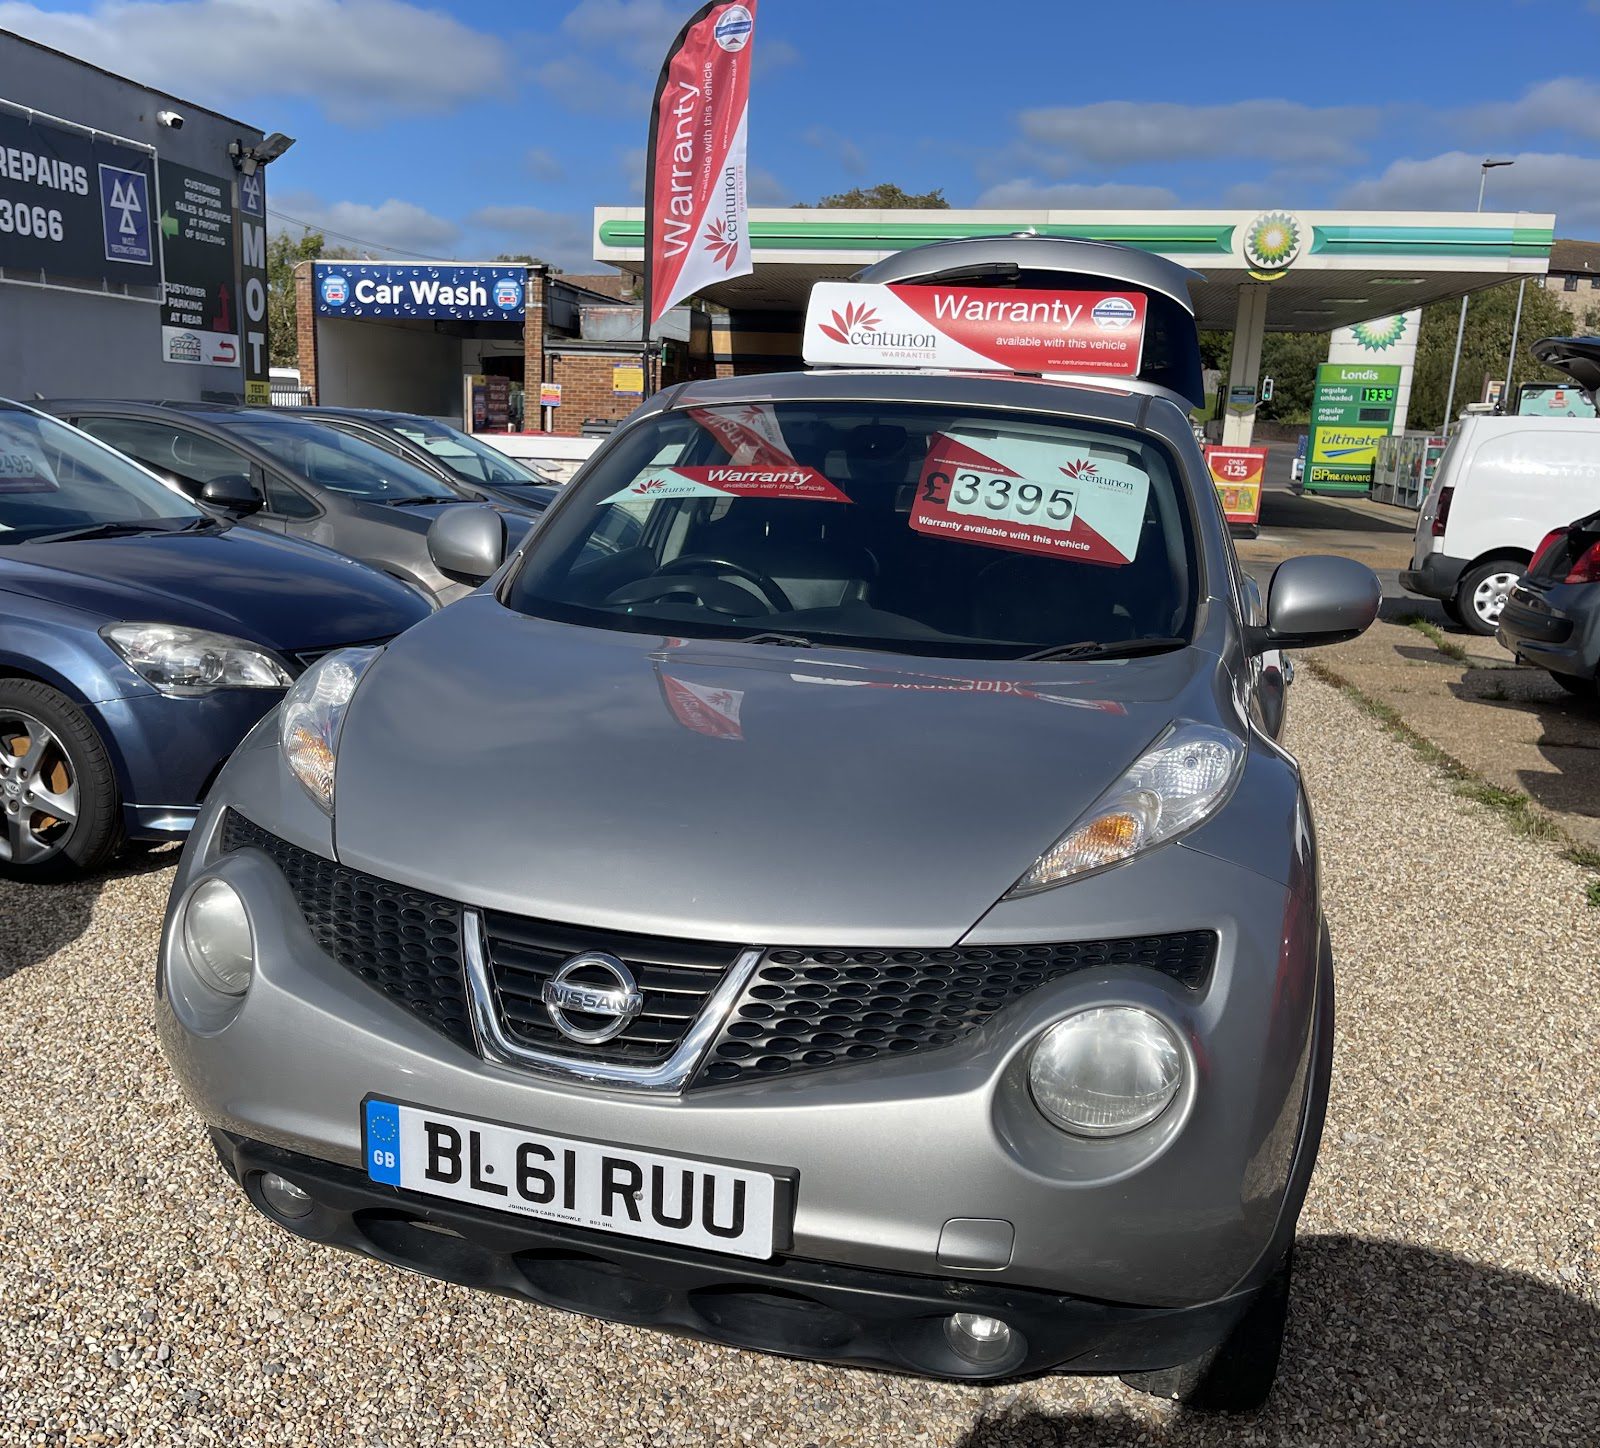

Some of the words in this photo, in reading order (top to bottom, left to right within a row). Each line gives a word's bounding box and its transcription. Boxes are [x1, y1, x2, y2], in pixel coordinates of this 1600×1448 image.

[703, 62, 713, 102] vehicle
[703, 105, 712, 126] this
[703, 131, 713, 154] with
[663, 81, 700, 259] Warranty
[175, 201, 197, 215] SALES
[725, 166, 738, 242] centurion
[163, 281, 207, 298] CUSTOMER
[355, 279, 403, 304] Car
[409, 280, 488, 307] Wash
[168, 297, 203, 312] PARKING
[934, 293, 1083, 332] Warranty
[170, 312, 180, 323] AT
[181, 313, 202, 325] REAR
[850, 330, 936, 348] centurion
[996, 336, 1041, 348] available
[1044, 337, 1067, 349] with
[1068, 338, 1087, 349] this
[1090, 339, 1127, 351] vehicle
[881, 351, 937, 360] WARRANTIES
[1341, 369, 1379, 380] Londis
[251, 384, 264, 394] TEST
[1321, 387, 1348, 395] regular
[1320, 394, 1353, 402] unleaded
[1317, 414, 1339, 422] diesel
[1318, 407, 1345, 415] regular
[707, 469, 814, 486] Warranty
[796, 484, 826, 492] vehicle
[918, 515, 962, 532] Warranty
[963, 523, 1007, 538] available
[1009, 530, 1031, 542] with
[1032, 535, 1051, 545] this
[1054, 538, 1091, 551] vehicle
[545, 984, 630, 1014] NISSAN
[373, 1149, 395, 1169] GB
[424, 1121, 576, 1211] BL61
[601, 1156, 747, 1240] RUU
[508, 1203, 539, 1214] JOHNSONS
[540, 1210, 556, 1218] CARS
[557, 1214, 582, 1223] KNOWLE
